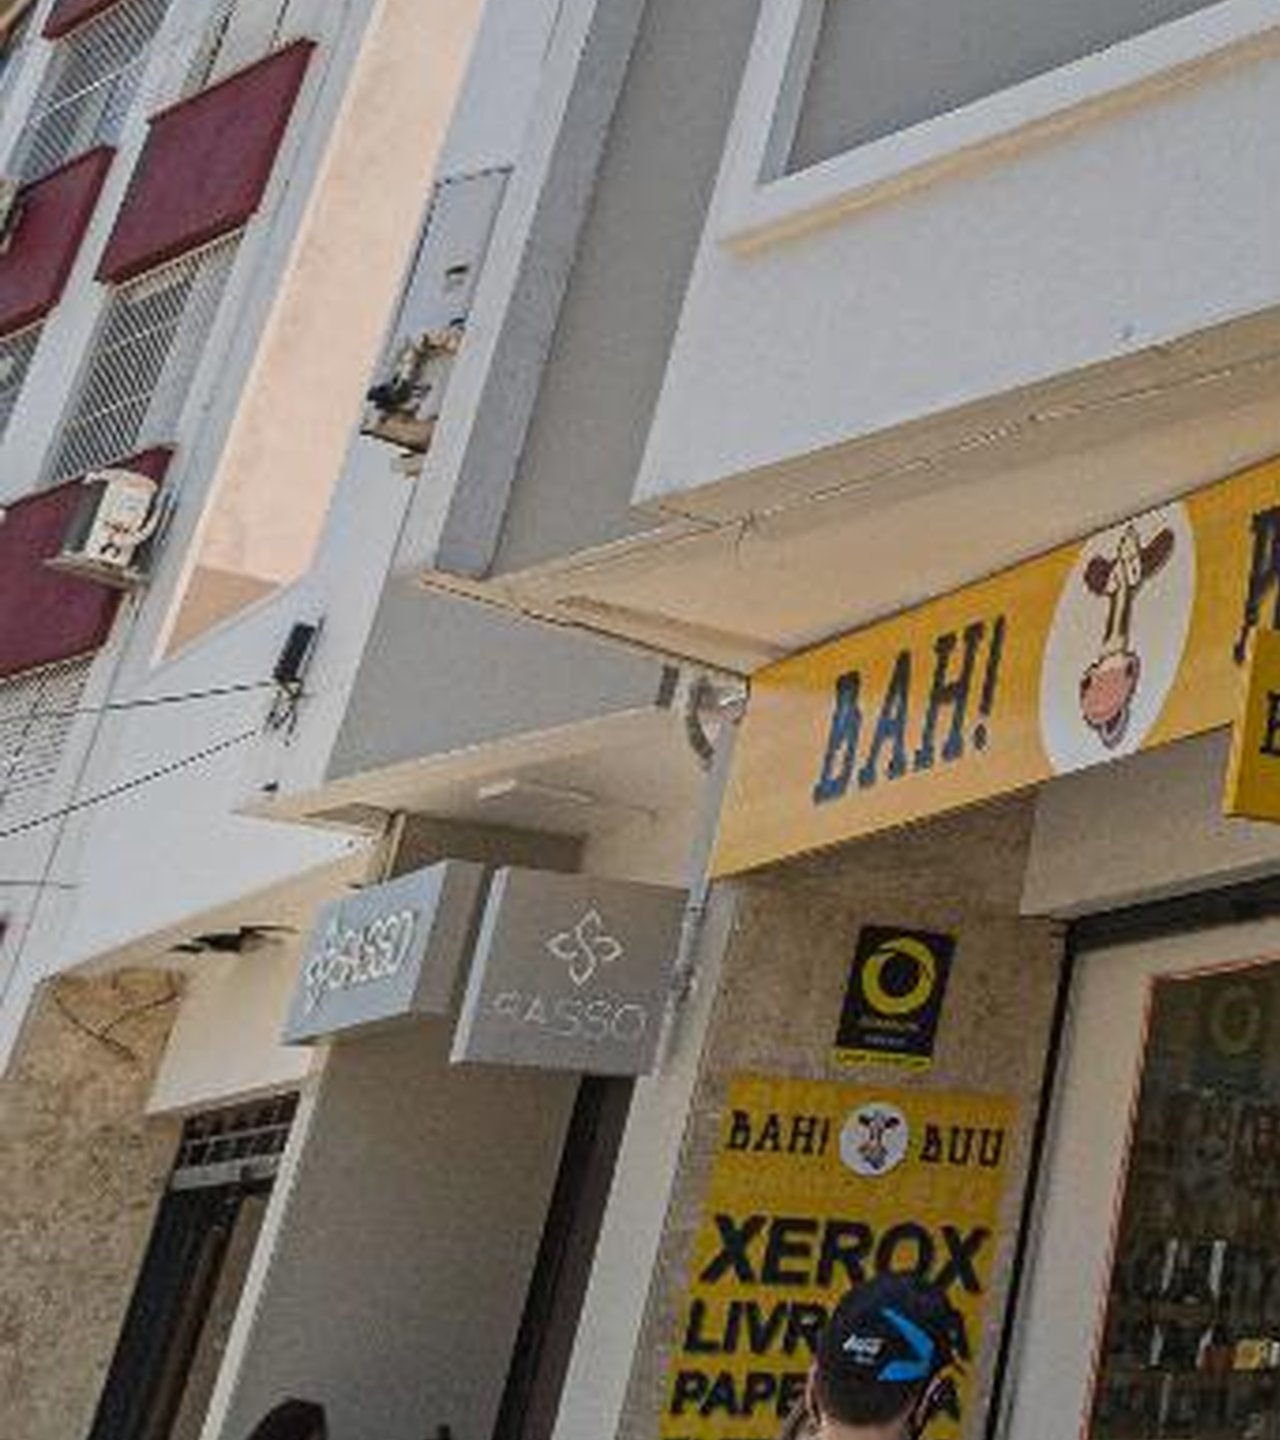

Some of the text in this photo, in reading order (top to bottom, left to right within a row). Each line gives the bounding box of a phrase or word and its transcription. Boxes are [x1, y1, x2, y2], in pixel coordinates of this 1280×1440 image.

[813, 615, 1005, 805] BAH!
[726, 1109, 1004, 1167] BAH! BUU
[700, 1212, 990, 1293] XEROX
[683, 1300, 970, 1360] LIVRA
